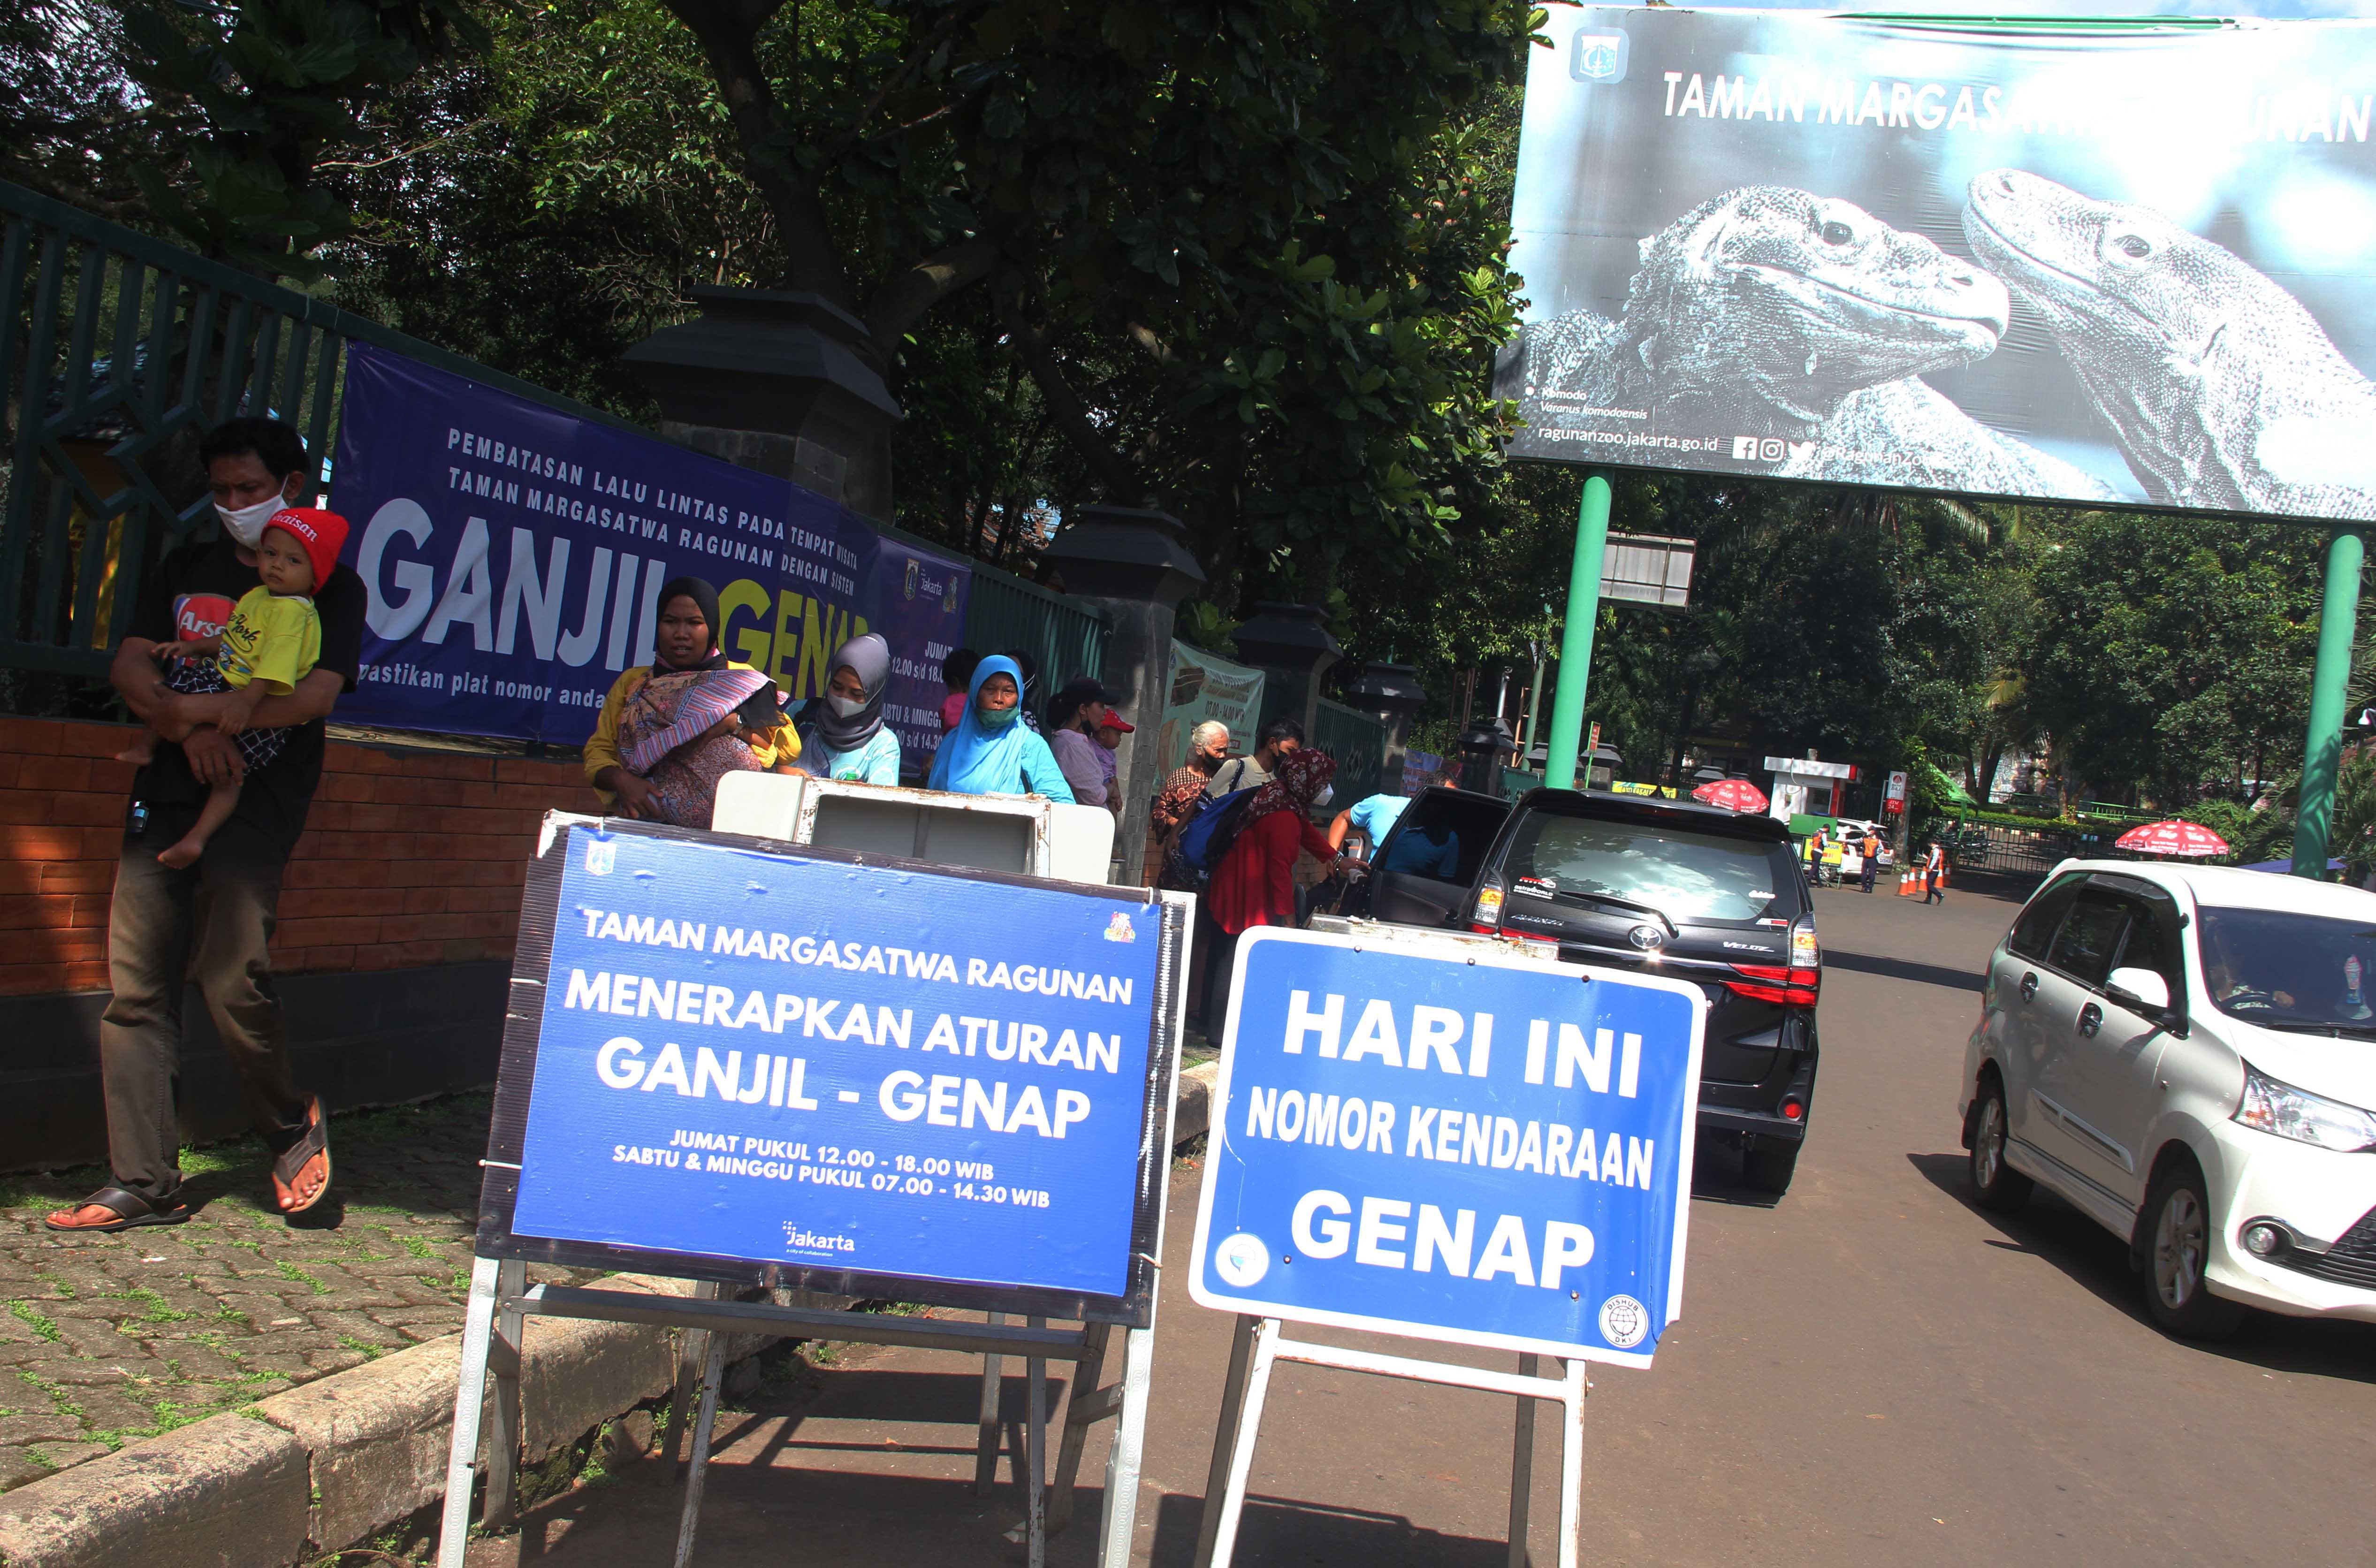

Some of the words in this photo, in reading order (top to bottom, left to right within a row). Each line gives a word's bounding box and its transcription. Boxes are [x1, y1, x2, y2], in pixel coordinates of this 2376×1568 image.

[1664, 71, 1805, 122] TAMAN
[1817, 81, 2095, 137] MARGAS
[2235, 93, 2373, 143] UNAN
[1541, 401, 1580, 414] Varanus
[1583, 404, 1648, 420] komodoensis
[1542, 388, 1587, 400] Komodo
[1538, 426, 1718, 451] ragunanzoo.jakarta.go.id
[448, 427, 582, 486] PEMBATASAN
[594, 471, 647, 503] LALU
[657, 489, 728, 525] LINTAS
[738, 511, 784, 540] PADA
[792, 526, 835, 557] TEMPAT
[837, 544, 857, 571] WISATA
[449, 467, 519, 504] TAMAN
[527, 488, 668, 543] MARGASATWA
[679, 528, 773, 568] RAGUNAN
[781, 554, 828, 584] DENGAN
[831, 571, 854, 597] SISTEM
[357, 497, 666, 672] GANJIL
[358, 662, 444, 690] pastikan
[451, 671, 489, 697] plat
[495, 681, 552, 702] nomor
[559, 686, 605, 710] anda
[892, 657, 912, 677] 12.00
[913, 662, 927, 680] s/d
[929, 665, 944, 683] 18.
[882, 703, 902, 722] ABTU
[903, 706, 909, 724] &
[906, 731, 919, 749] s/d
[583, 908, 706, 951] TAMAN
[712, 926, 959, 983] MARGASATWA
[967, 958, 1133, 1005] RAGUNAN
[1723, 941, 1775, 952] VELOZ
[564, 968, 913, 1049] MENERAPKAN
[921, 1013, 1121, 1073] ATURAN
[1283, 990, 1493, 1078] HARI
[1524, 1019, 1642, 1099] INI
[596, 1036, 818, 1111] GANJIL
[838, 1090, 860, 1103] -
[879, 1070, 1091, 1139] GENAP
[670, 1129, 740, 1153] JUMAT
[744, 1137, 811, 1161] PUKUL
[817, 1146, 875, 1168] 12.00
[895, 1154, 951, 1176] 18.00
[955, 1160, 994, 1180] WIB
[1246, 1086, 1396, 1155] NOMOR
[1406, 1105, 1654, 1190] KENDARAAN
[612, 1144, 680, 1168] SABTU
[685, 1153, 701, 1171] &
[706, 1155, 793, 1180] MINGGU
[798, 1165, 865, 1189] PUKUL
[871, 1174, 933, 1196] 07.00
[953, 1182, 1007, 1203] 14.30
[1012, 1188, 1051, 1208] WIB
[1291, 1189, 1595, 1290] GENAP
[1607, 1299, 1639, 1311] DISHUB
